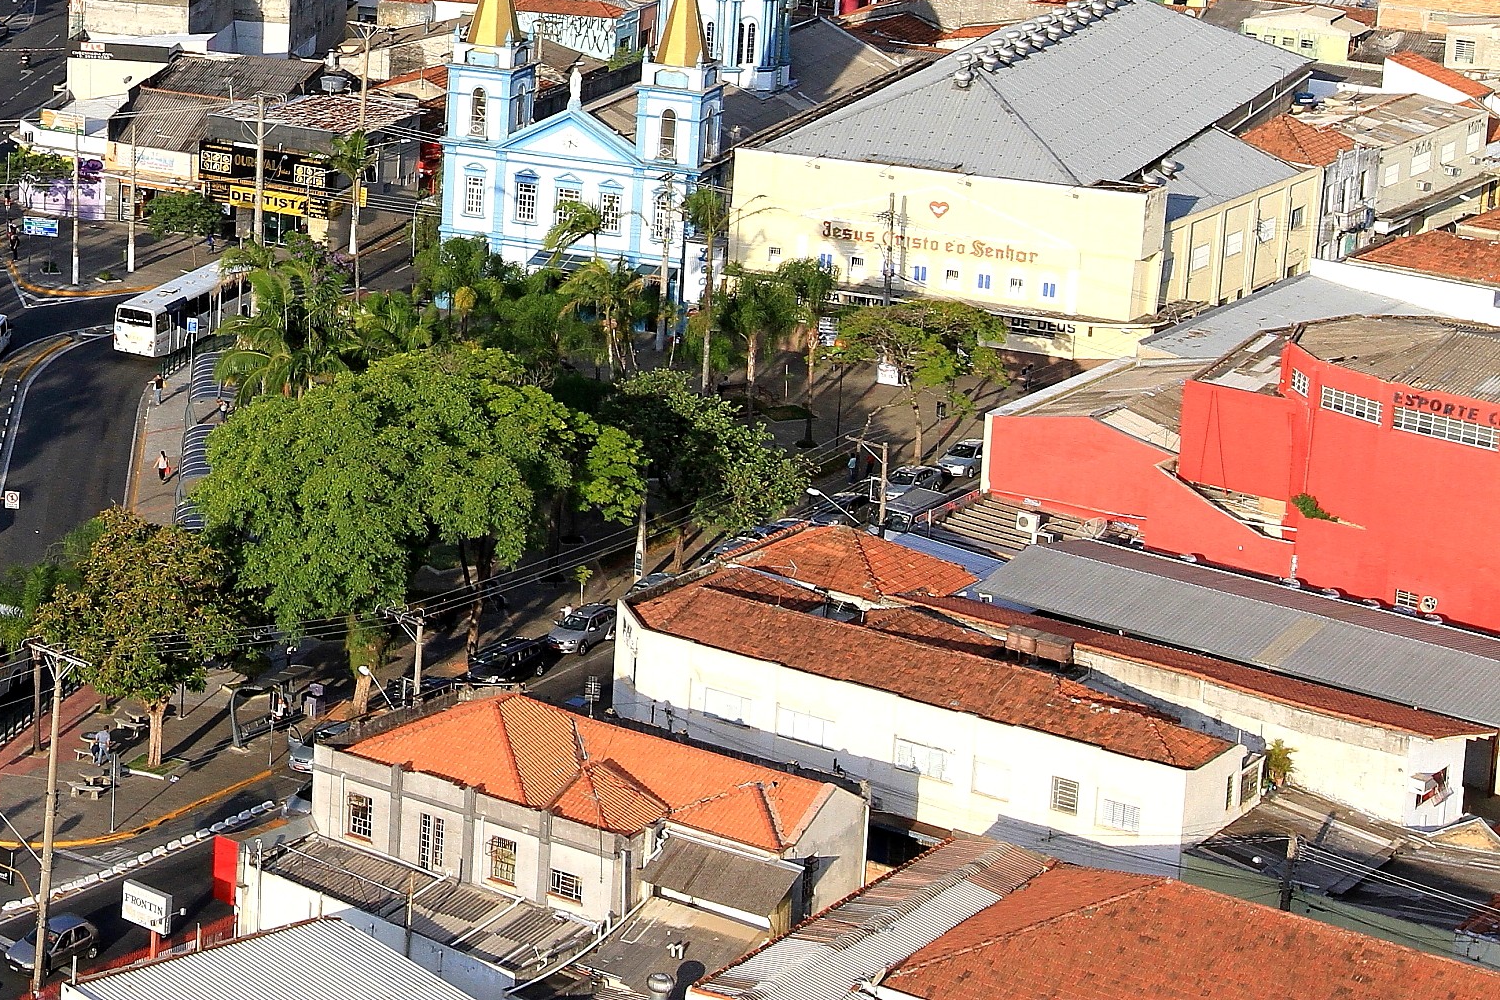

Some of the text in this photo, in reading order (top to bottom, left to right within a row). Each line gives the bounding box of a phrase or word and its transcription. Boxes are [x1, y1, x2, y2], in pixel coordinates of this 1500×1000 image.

[822, 220, 875, 243] Jesus
[970, 239, 1039, 263] Senhor
[1011, 317, 1076, 334] DE DEUS
[1393, 391, 1479, 421] ESPORTE
[124, 892, 163, 916] FRONTIN
